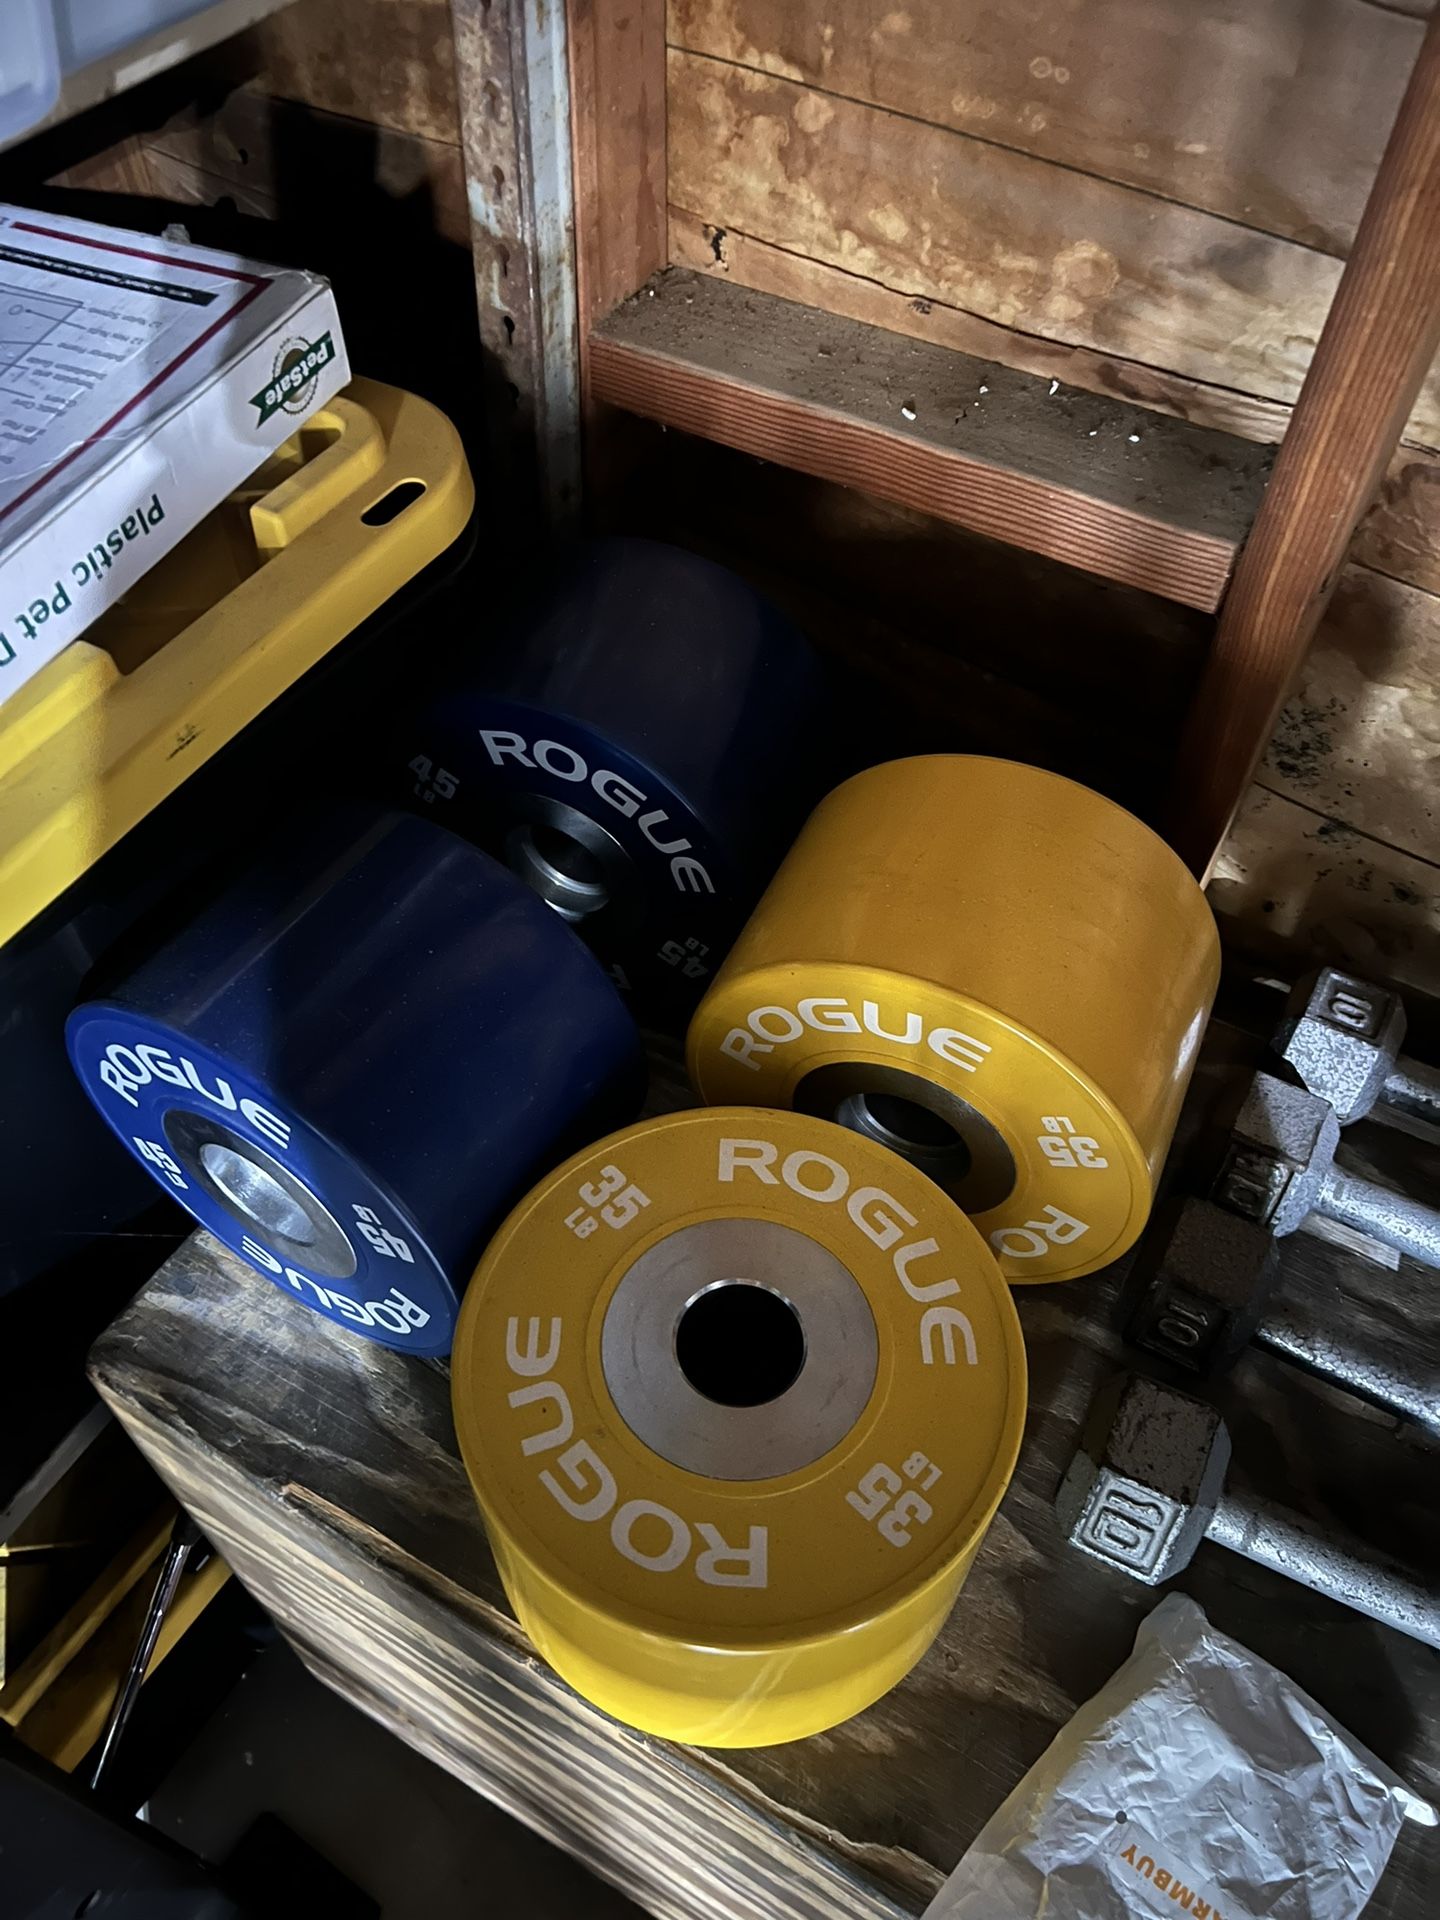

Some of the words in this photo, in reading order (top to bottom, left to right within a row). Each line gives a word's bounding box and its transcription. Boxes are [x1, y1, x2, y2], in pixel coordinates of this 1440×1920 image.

[265, 342, 328, 405] PetSafe
[71, 493, 166, 587] Plastic
[15, 580, 73, 640] Pet
[408, 754, 460, 799] 45
[479, 729, 716, 894] ROGUE
[656, 940, 710, 978] 45
[720, 998, 993, 1073] ROGUE
[1330, 991, 1373, 1029] 10
[100, 1044, 292, 1149] ROGUE
[1040, 1116, 1076, 1134] LB
[132, 1136, 182, 1175] 45
[1036, 1136, 1109, 1169] 35
[352, 1204, 382, 1226] LB
[564, 1206, 599, 1239] LB
[578, 1164, 651, 1230] 35
[355, 1221, 415, 1264] 45
[717, 1138, 978, 1366] ROGUE
[242, 1235, 431, 1334] ROGUE
[1158, 1302, 1208, 1347] 10
[505, 1316, 768, 1589] ROGUE
[902, 1451, 943, 1491] LB
[844, 1462, 934, 1548] 35
[1092, 1488, 1165, 1562] 10
